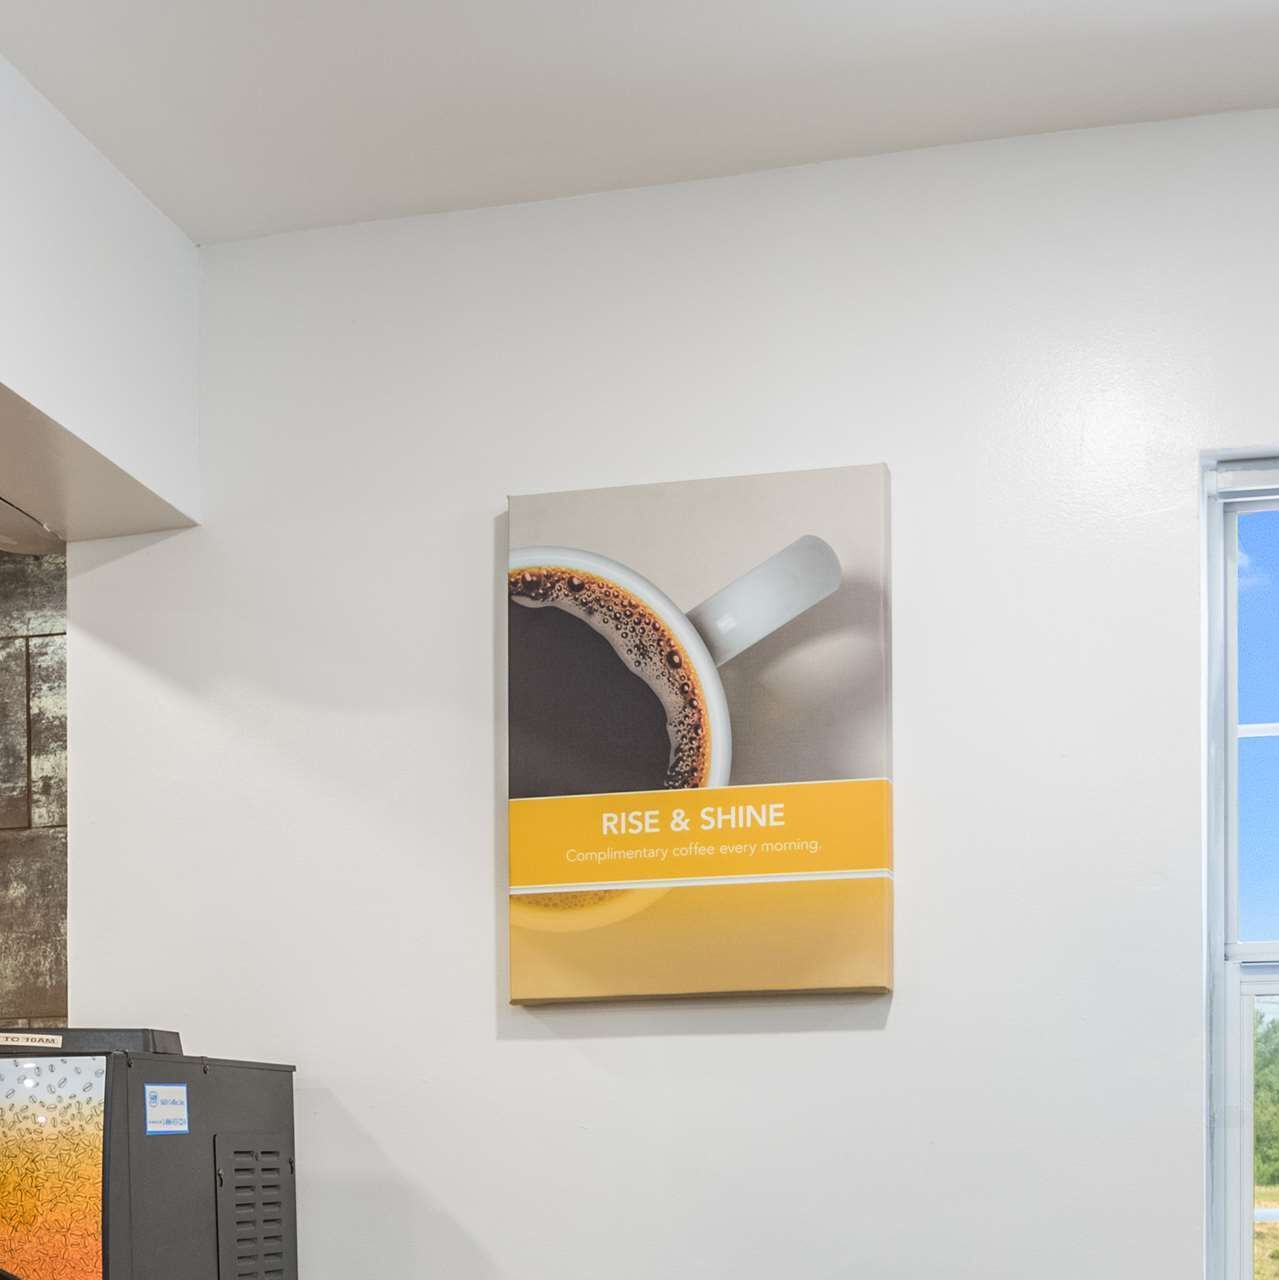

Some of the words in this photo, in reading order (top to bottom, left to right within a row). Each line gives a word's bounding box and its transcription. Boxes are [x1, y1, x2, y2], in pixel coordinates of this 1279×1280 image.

[601, 810, 660, 835] RISE
[670, 808, 690, 832] &
[700, 803, 785, 830] SHINE
[566, 846, 669, 864] Complimentary
[672, 841, 715, 857] coffee
[719, 841, 757, 856] every
[760, 838, 822, 854] morning.
[24, 1036, 56, 1044] 10AM
